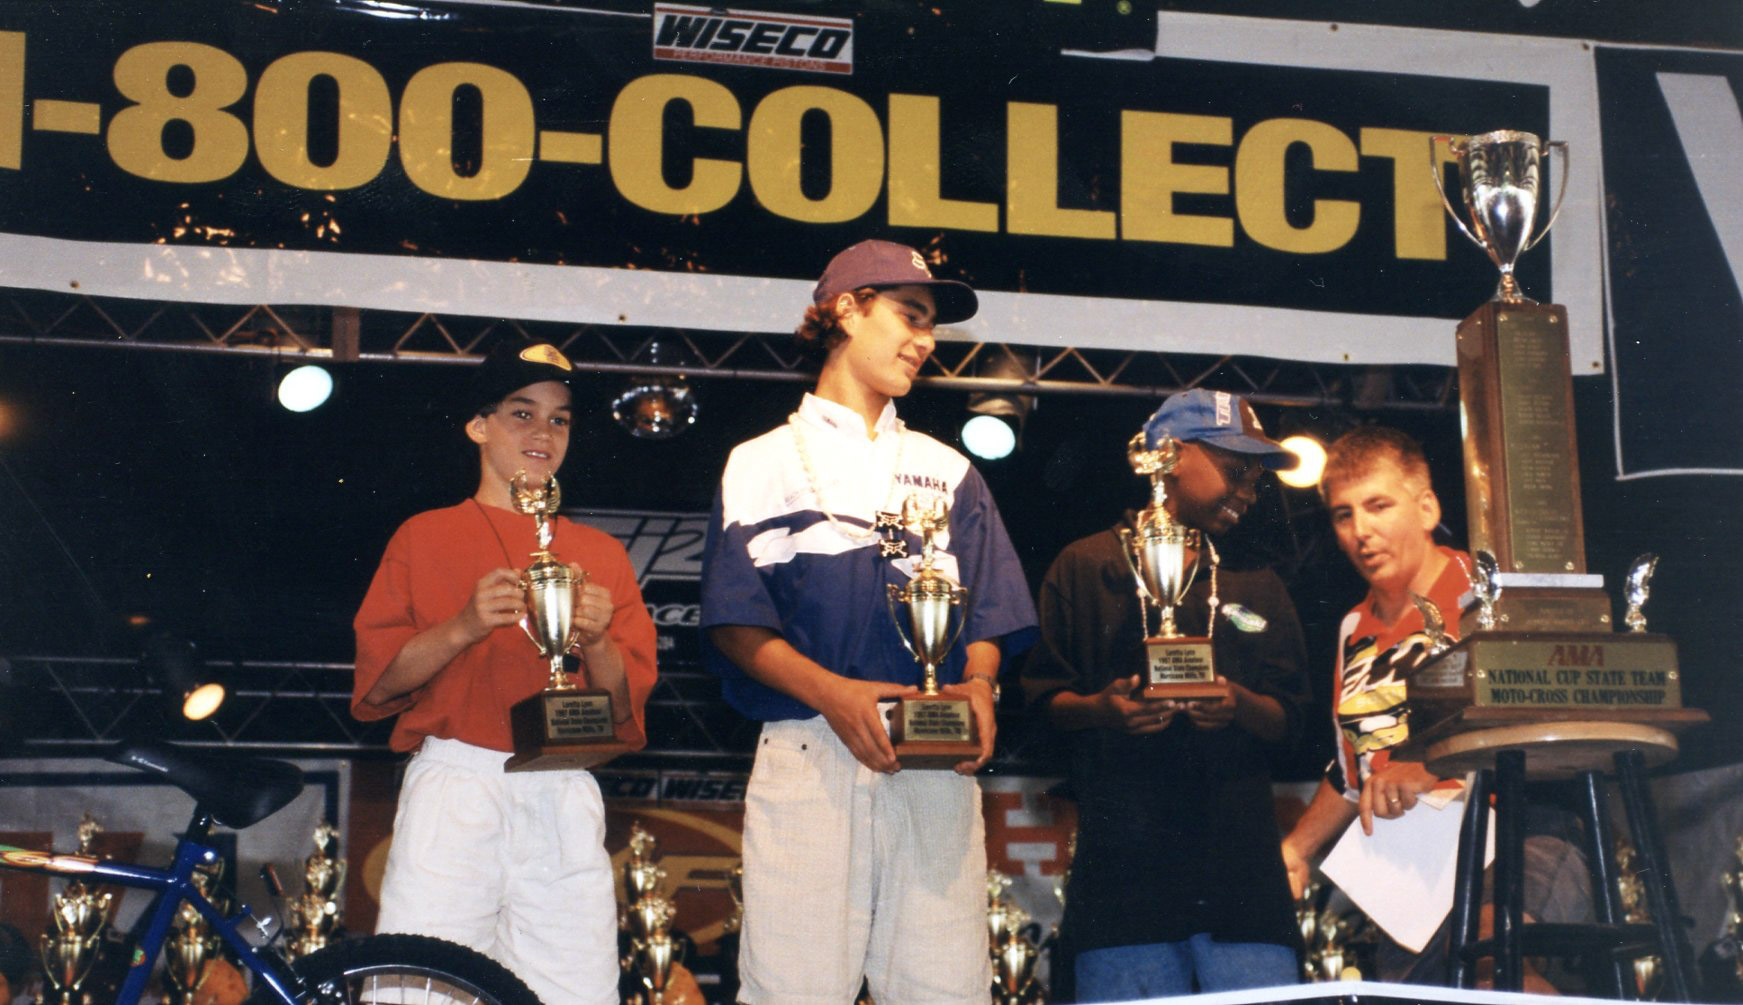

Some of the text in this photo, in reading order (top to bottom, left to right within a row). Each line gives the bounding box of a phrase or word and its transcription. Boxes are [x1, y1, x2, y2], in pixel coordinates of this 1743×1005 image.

[655, 14, 851, 60] WISECO
[894, 473, 948, 495] YAMAHA
[1548, 644, 1605, 667] AMA
[1488, 668, 1667, 686] NATIONAL CUP STATE TEAM
[1491, 687, 1666, 706] MOTO-CROSS CHAMPIONSHIP
